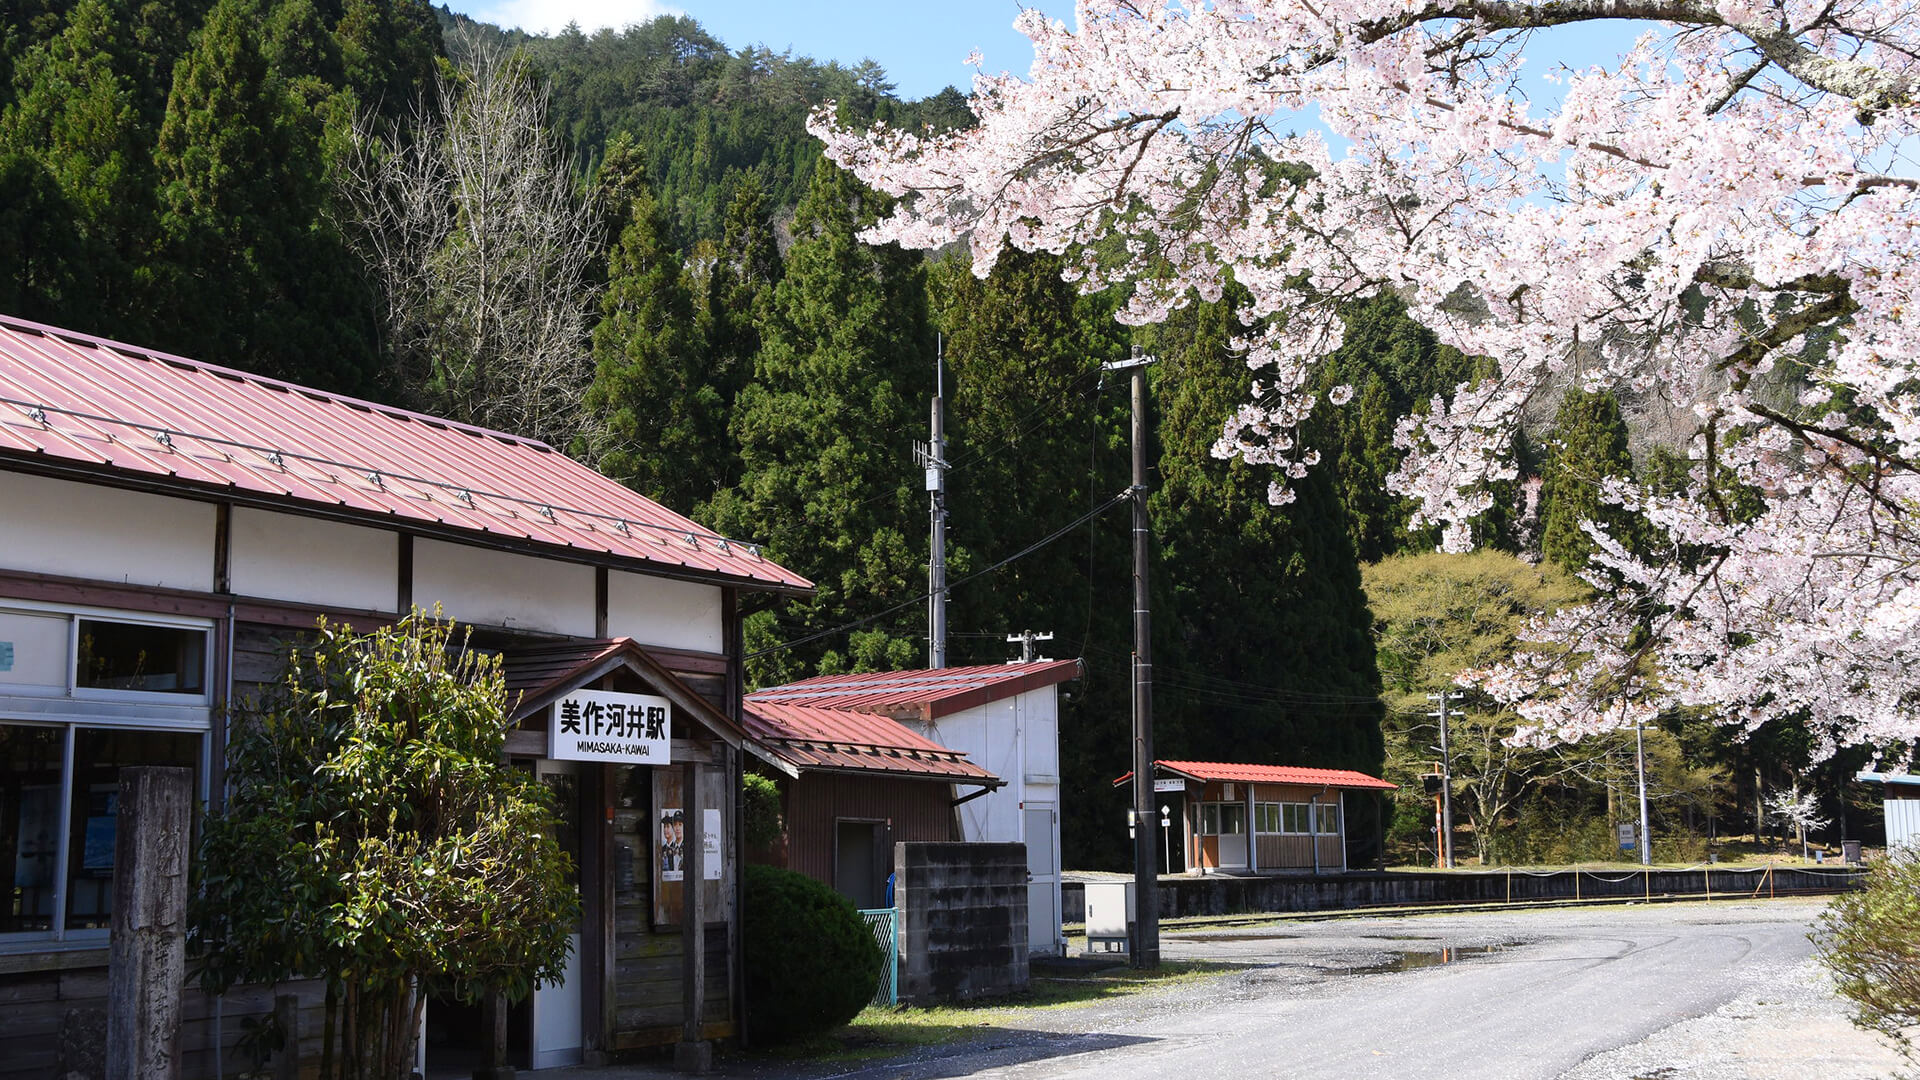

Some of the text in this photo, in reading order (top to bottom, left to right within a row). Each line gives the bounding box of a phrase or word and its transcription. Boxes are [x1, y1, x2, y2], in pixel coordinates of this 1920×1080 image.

[561, 699, 665, 740] 美作河井駅
[577, 741, 650, 756] MIMASAKA-KAWAI
